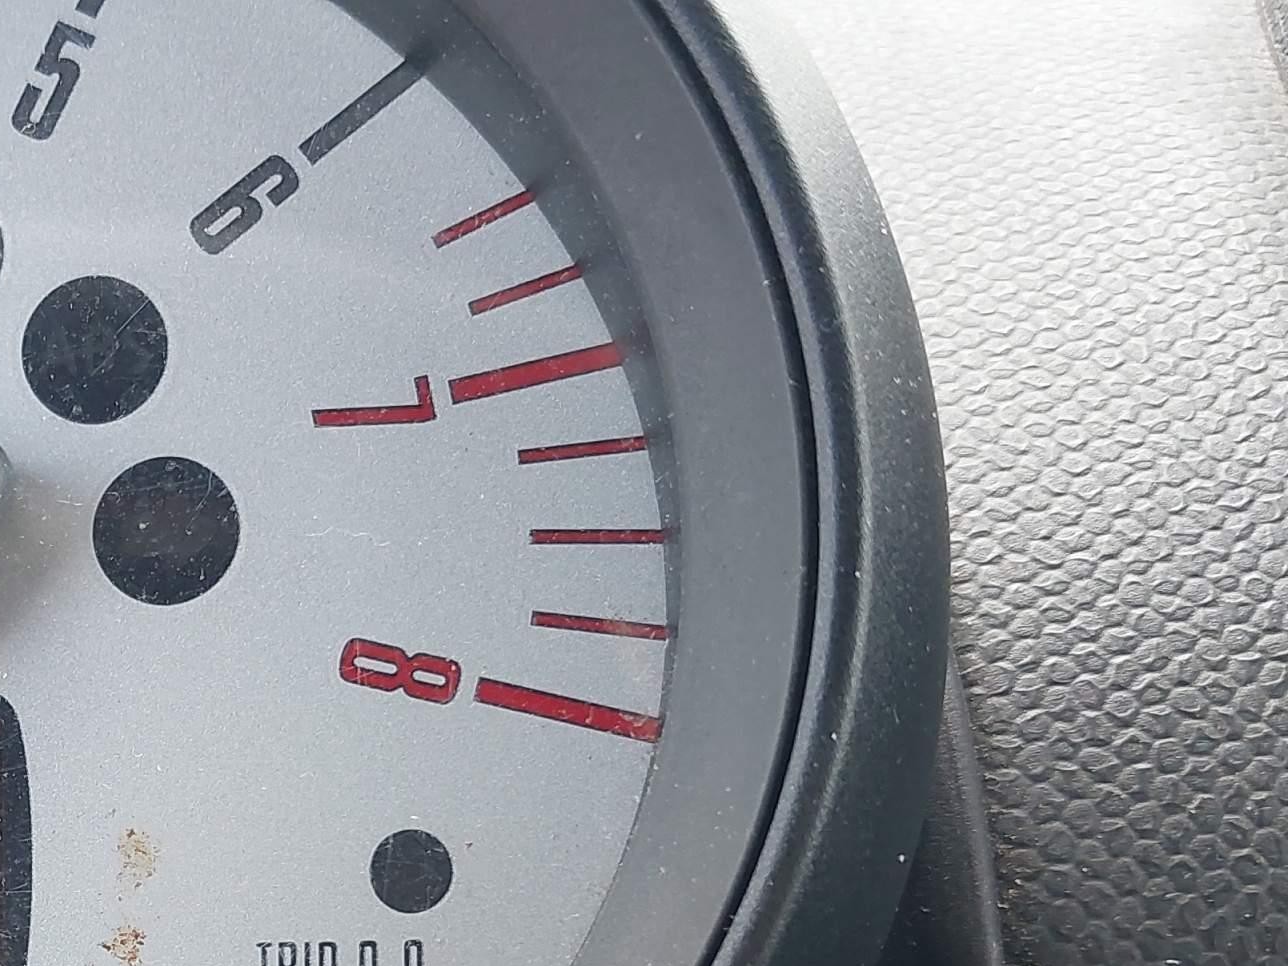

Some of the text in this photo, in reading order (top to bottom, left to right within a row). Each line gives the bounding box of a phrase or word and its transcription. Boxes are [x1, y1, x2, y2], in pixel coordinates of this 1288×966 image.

[11, 21, 95, 140] 5
[189, 154, 300, 255] 6
[311, 374, 437, 429] 7
[339, 637, 462, 704] 8
